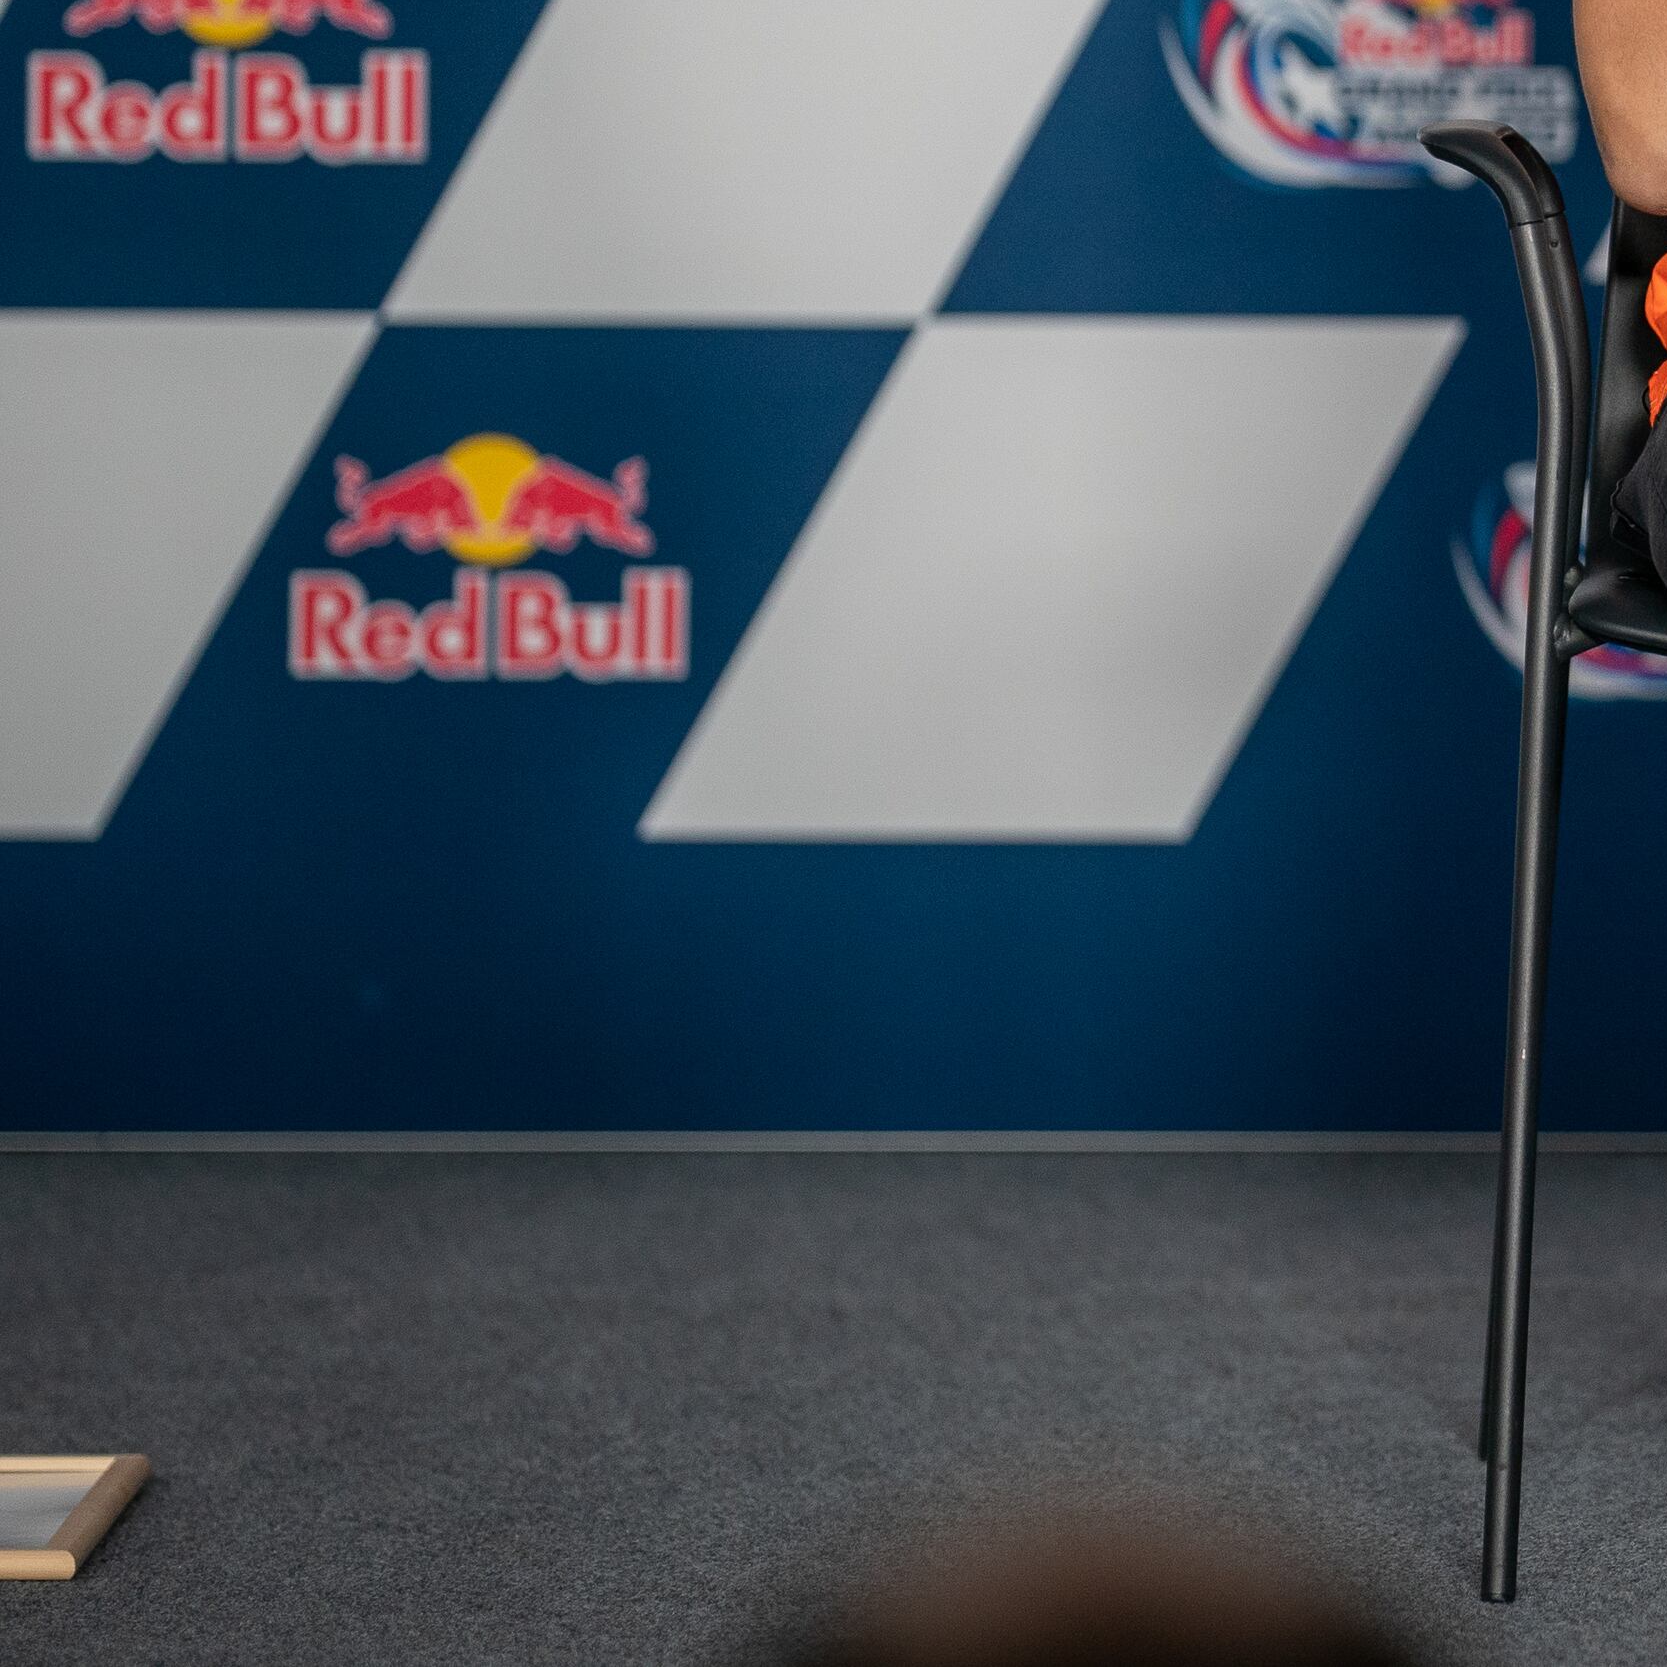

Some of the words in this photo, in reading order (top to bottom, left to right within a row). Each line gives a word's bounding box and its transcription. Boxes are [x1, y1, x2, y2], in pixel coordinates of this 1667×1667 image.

[1338, 10, 1431, 65] Red
[1437, 9, 1534, 66] Bull
[32, 56, 225, 154] Red
[236, 54, 423, 156] Bull
[295, 573, 486, 672] Red
[497, 573, 684, 674] Bull
